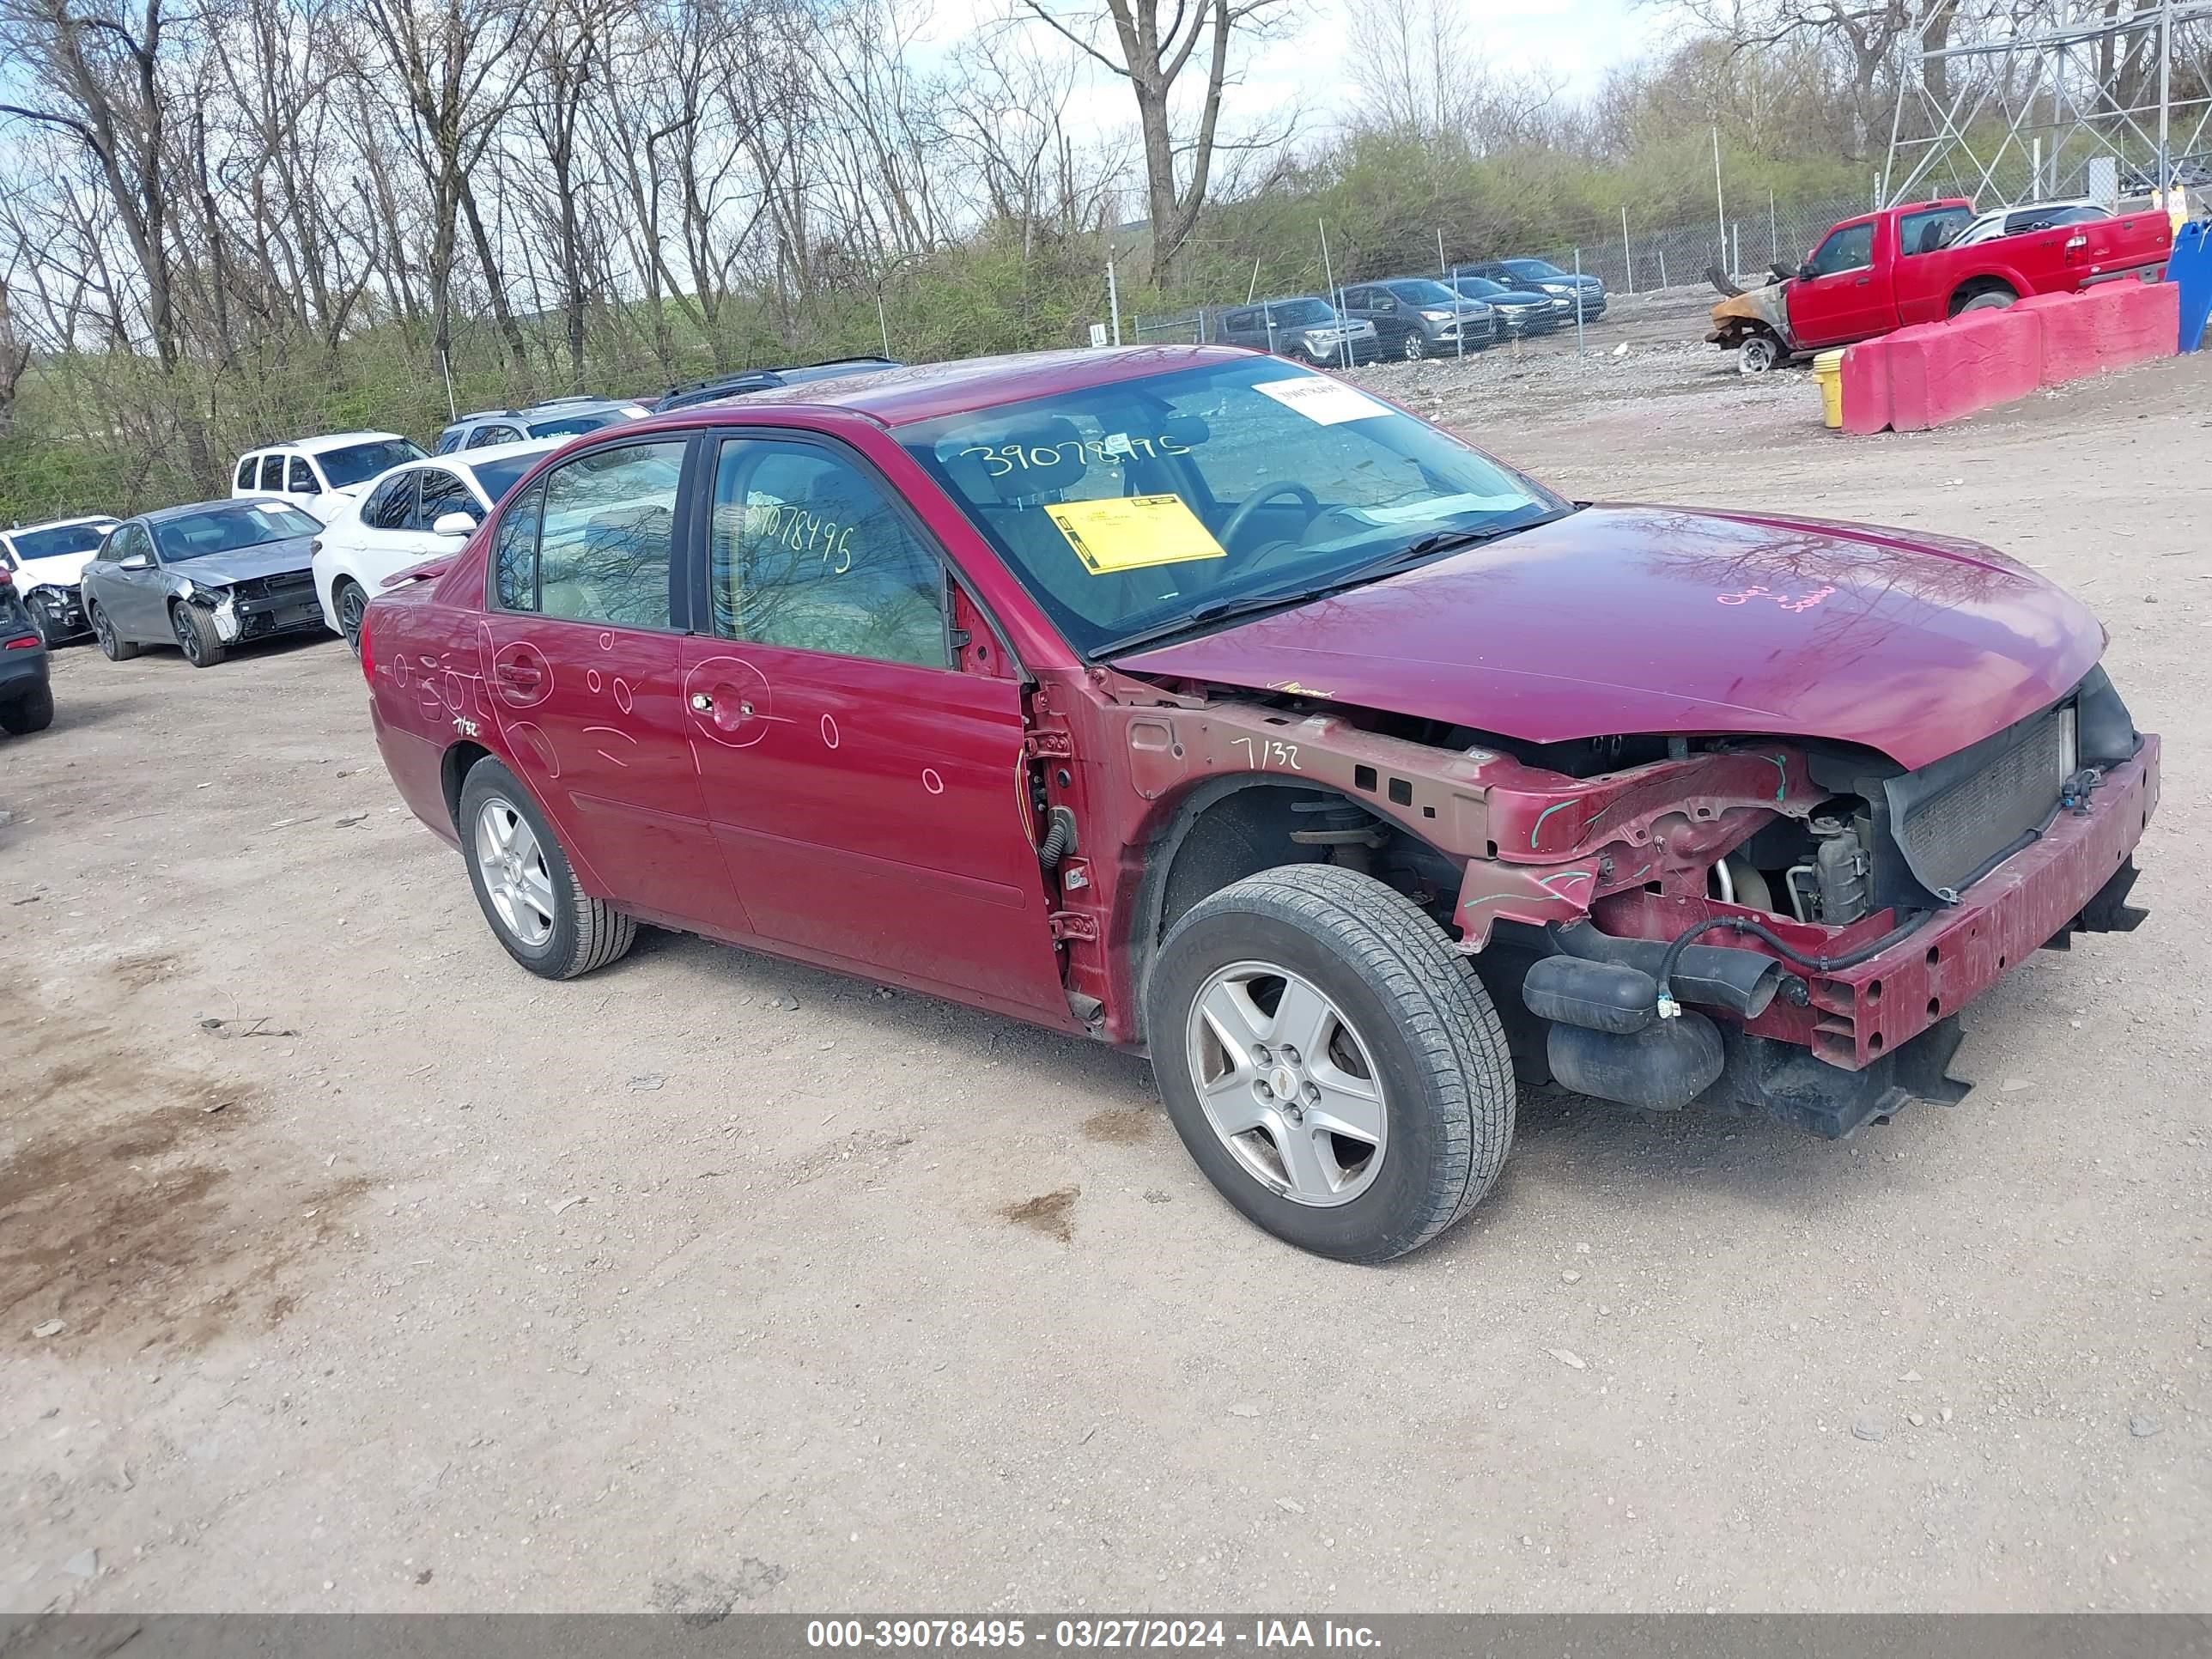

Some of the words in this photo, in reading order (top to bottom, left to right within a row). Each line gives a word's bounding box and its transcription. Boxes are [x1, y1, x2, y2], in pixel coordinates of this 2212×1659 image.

[959, 435, 1191, 477] 39078495
[453, 714, 478, 738] 7/32
[1230, 737, 1303, 770] 7/32
